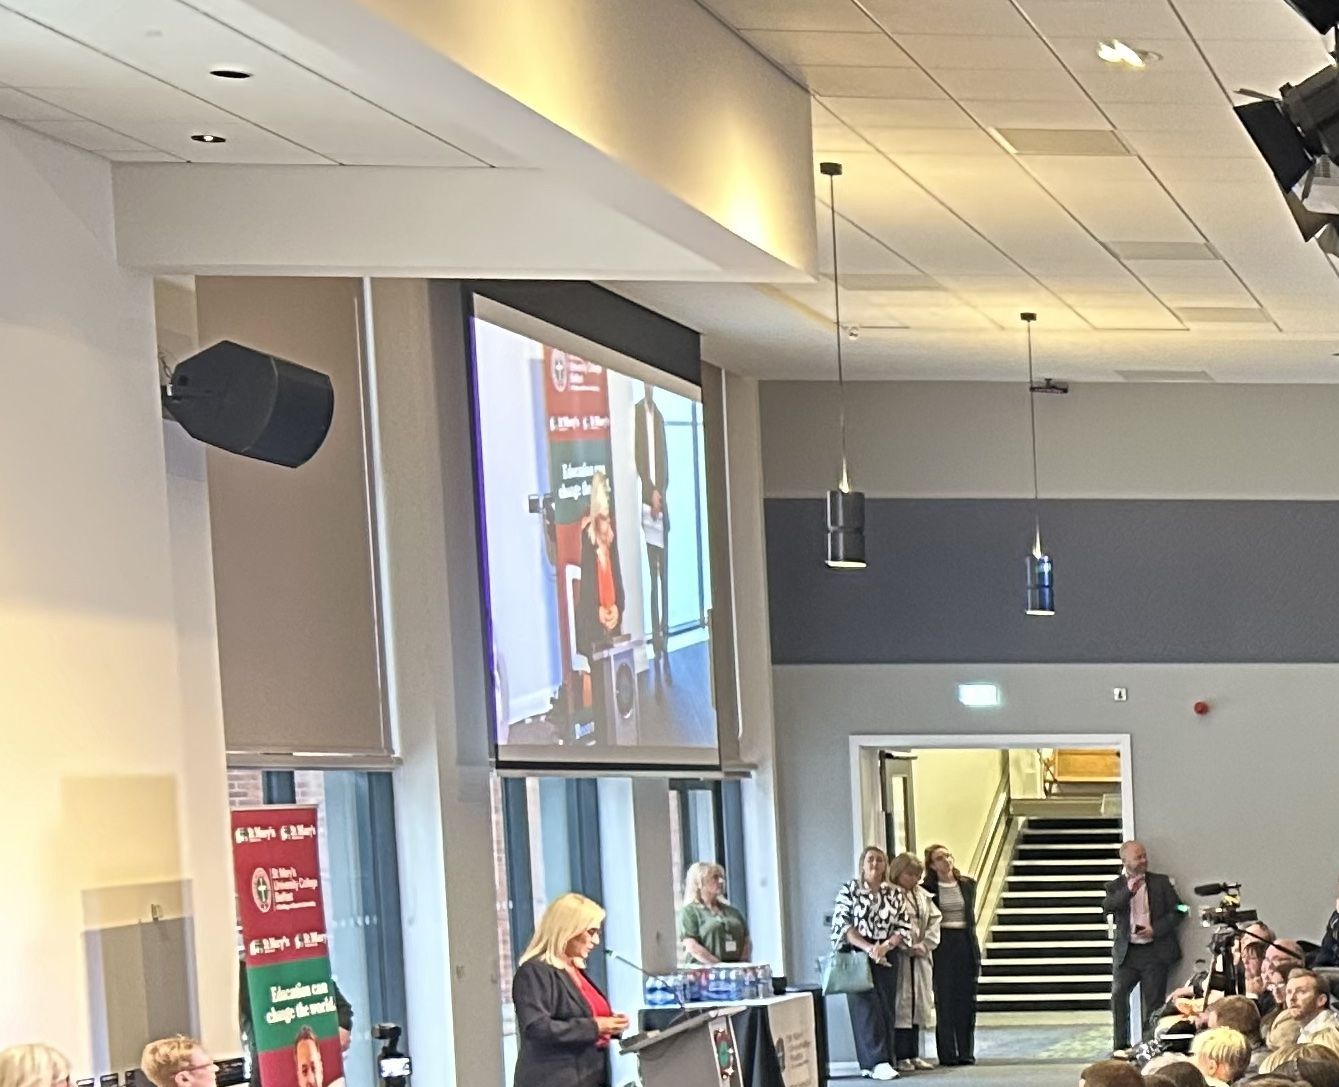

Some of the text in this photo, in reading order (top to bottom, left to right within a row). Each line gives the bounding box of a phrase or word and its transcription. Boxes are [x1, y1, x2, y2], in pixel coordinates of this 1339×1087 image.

[270, 982, 329, 1003] Education can
[266, 1006, 296, 1024] change
[295, 1001, 310, 1018] the
